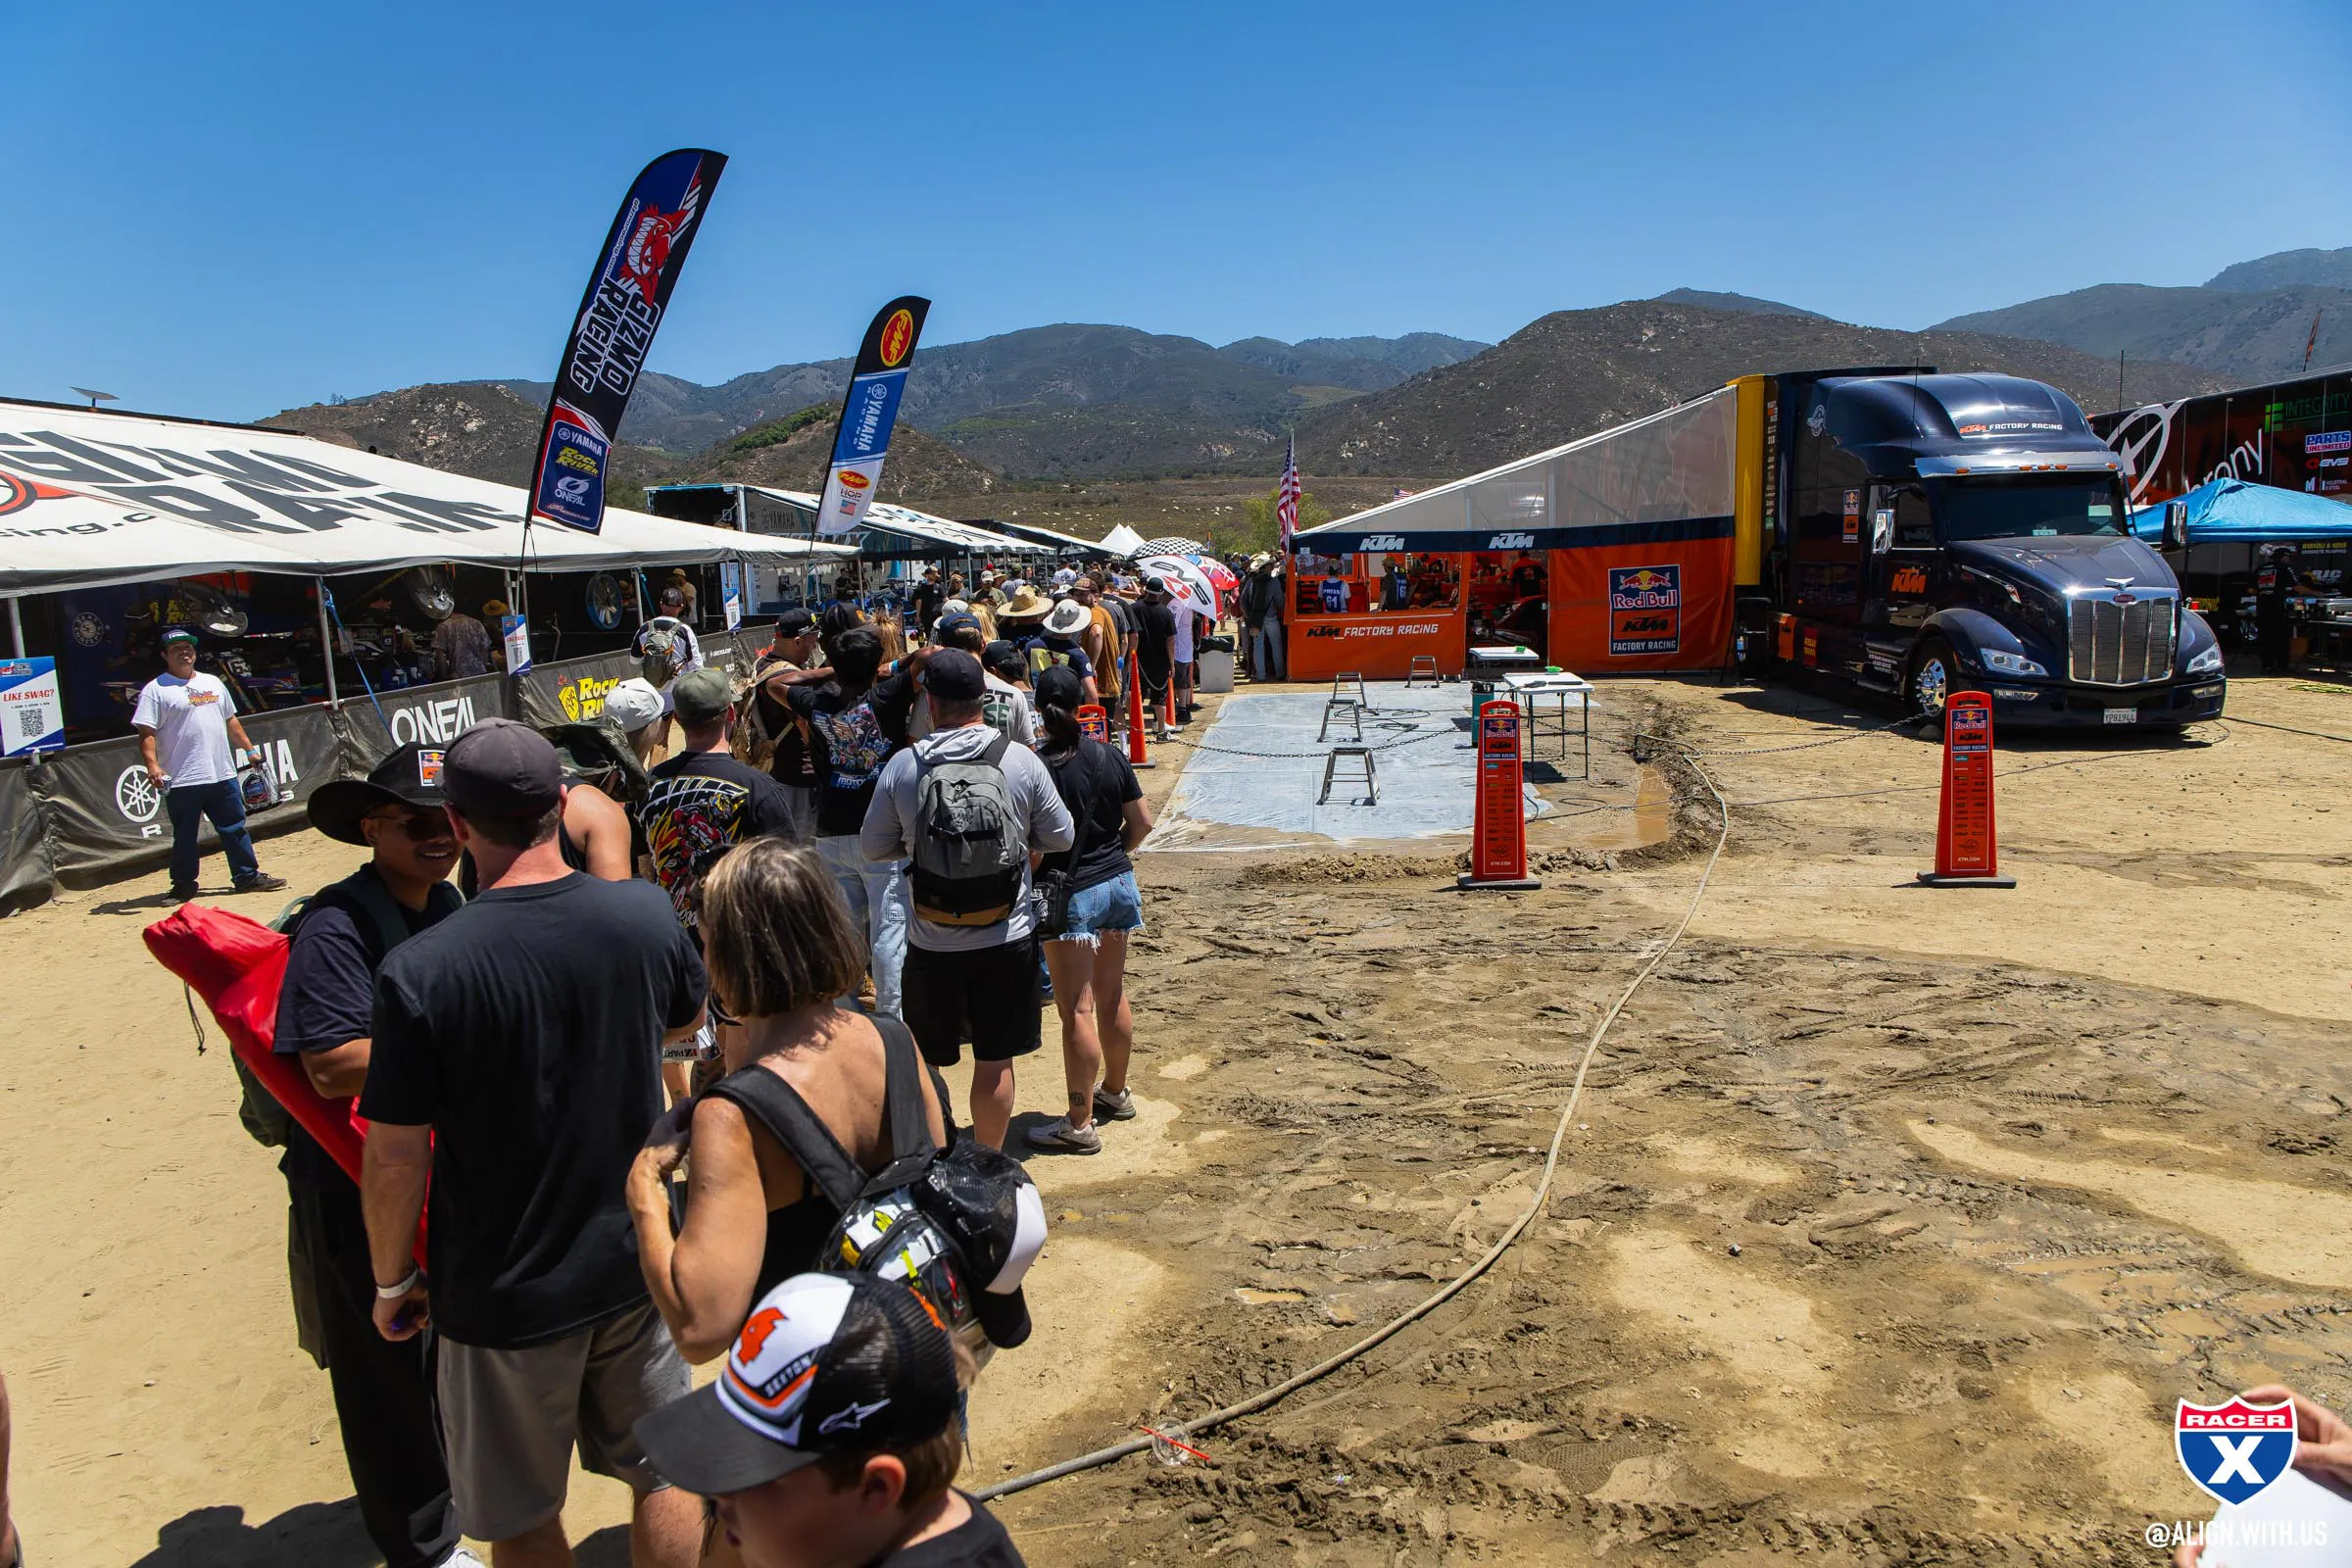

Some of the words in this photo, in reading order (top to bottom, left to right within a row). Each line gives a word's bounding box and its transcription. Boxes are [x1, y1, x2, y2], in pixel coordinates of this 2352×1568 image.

[606, 197, 640, 277] gizmoracing.com
[570, 275, 631, 394] RACING
[600, 291, 662, 396] GIZMO
[857, 400, 883, 452] YAMAHA
[1989, 422, 2029, 431] FACTORY
[571, 431, 603, 457] YAMAHA
[2305, 431, 2351, 446] PARTS
[2306, 442, 2351, 453] UNLIMITED
[1359, 534, 1405, 551] KTM
[1489, 532, 1535, 550] KTM
[1891, 567, 1928, 594] KTM
[1613, 593, 1645, 610] Red
[1646, 589, 1678, 608] Bull
[1306, 624, 1342, 638] KTM
[1344, 625, 1395, 637] FACTORY
[1622, 616, 1670, 633] KTM
[1612, 639, 1646, 652] FACTORY
[1647, 639, 1677, 651] RACING
[3, 691, 24, 703] LIKE
[24, 689, 55, 701] SWAG?
[576, 676, 620, 702] ROCK
